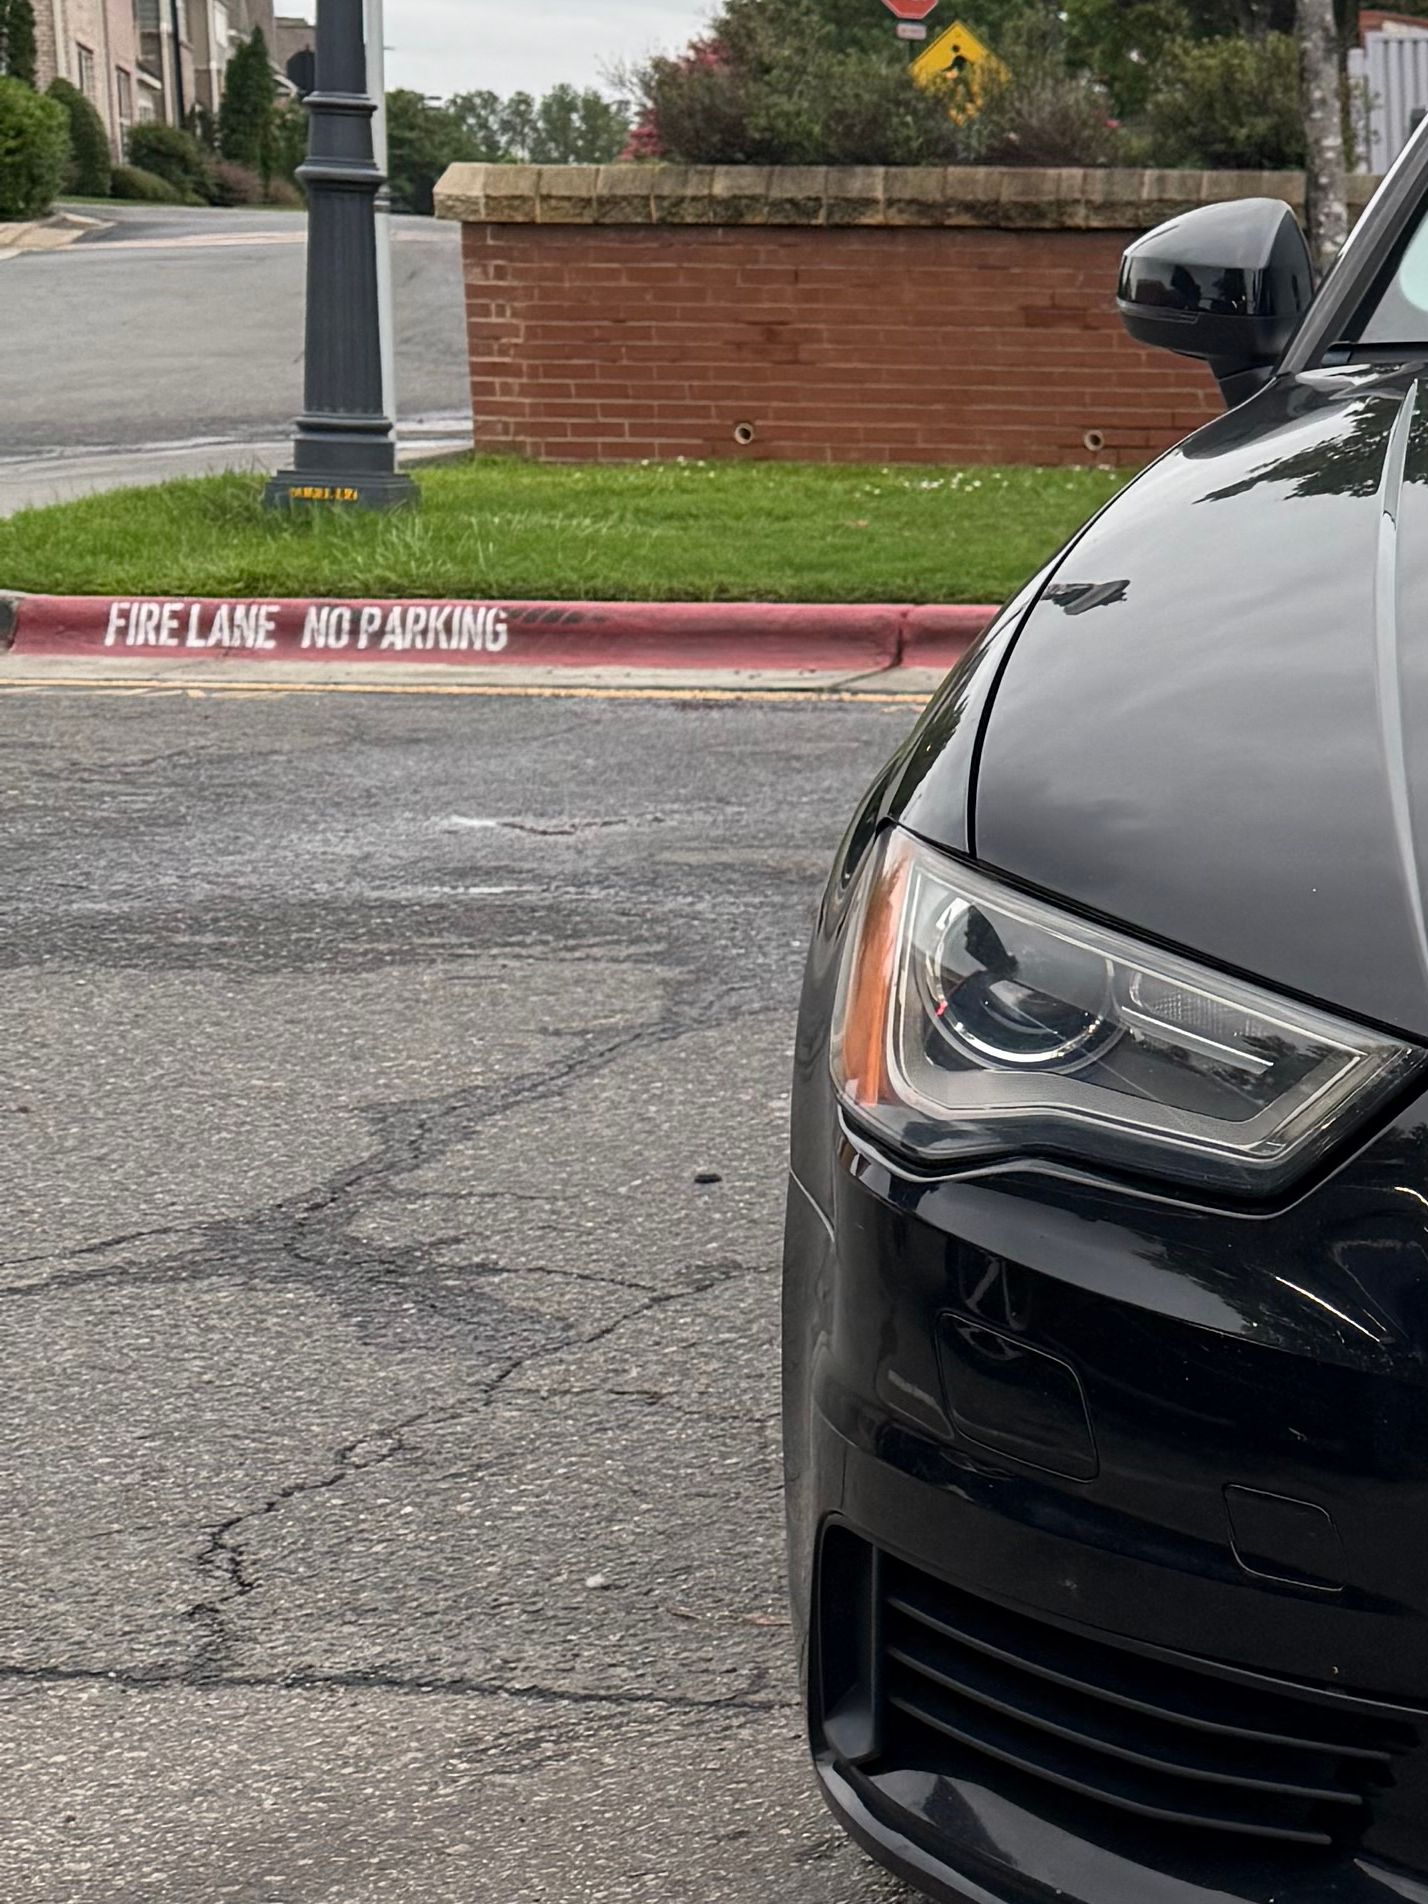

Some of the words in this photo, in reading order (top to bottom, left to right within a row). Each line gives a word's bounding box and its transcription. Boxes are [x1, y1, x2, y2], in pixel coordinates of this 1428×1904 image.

[104, 602, 183, 647] FIRE
[186, 604, 281, 649] LANE
[301, 606, 351, 650] NO
[358, 605, 508, 653] PARKING
